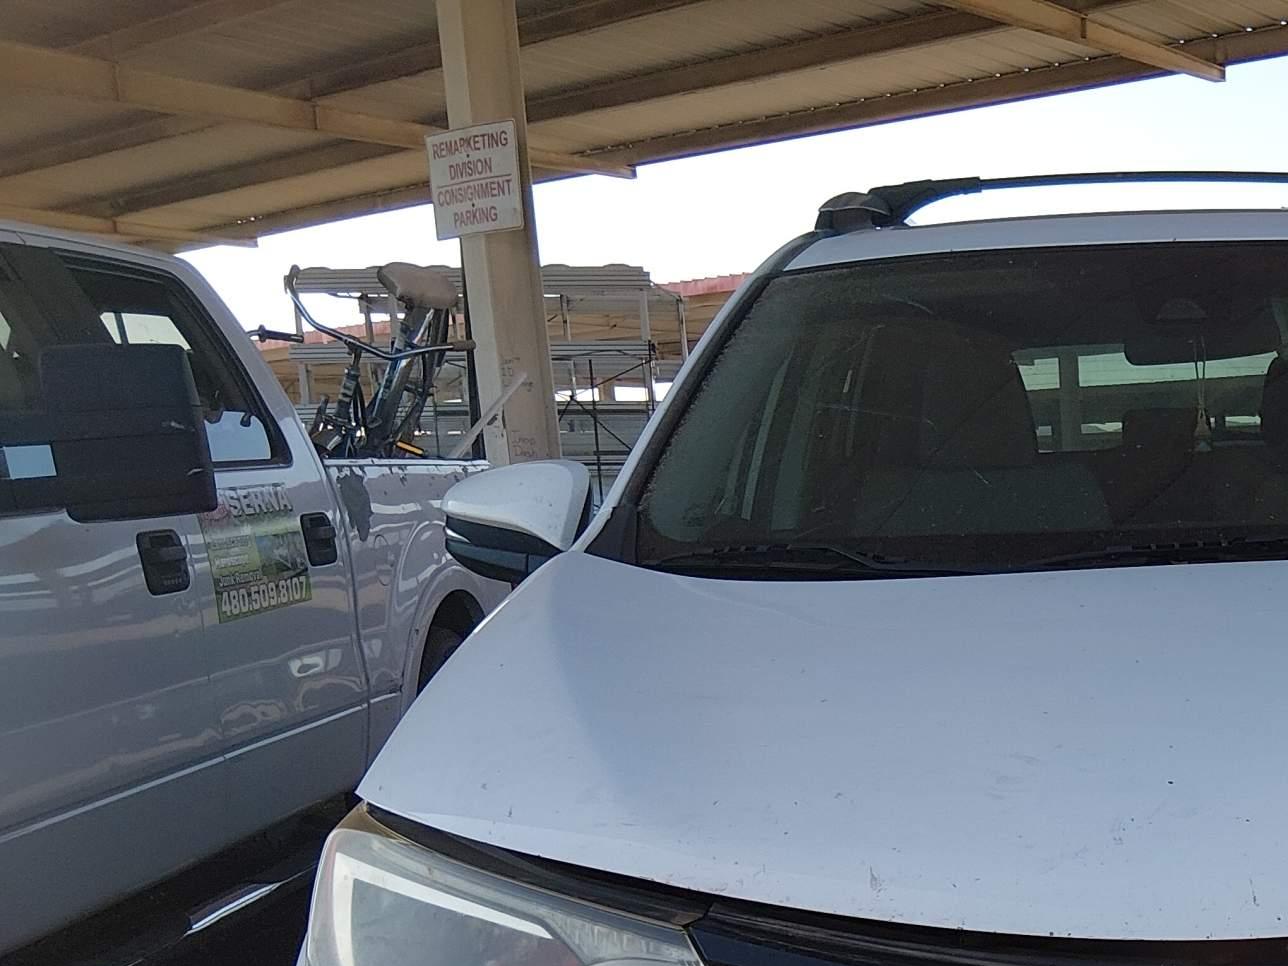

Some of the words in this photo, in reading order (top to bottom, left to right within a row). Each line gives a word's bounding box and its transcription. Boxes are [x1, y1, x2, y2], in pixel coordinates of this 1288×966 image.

[432, 130, 509, 160] REMARKETING
[448, 158, 493, 181] DIVISION
[437, 179, 512, 207] CONSIGNMENT
[454, 206, 498, 229] PARKING
[221, 576, 306, 616] 480.509.8107
